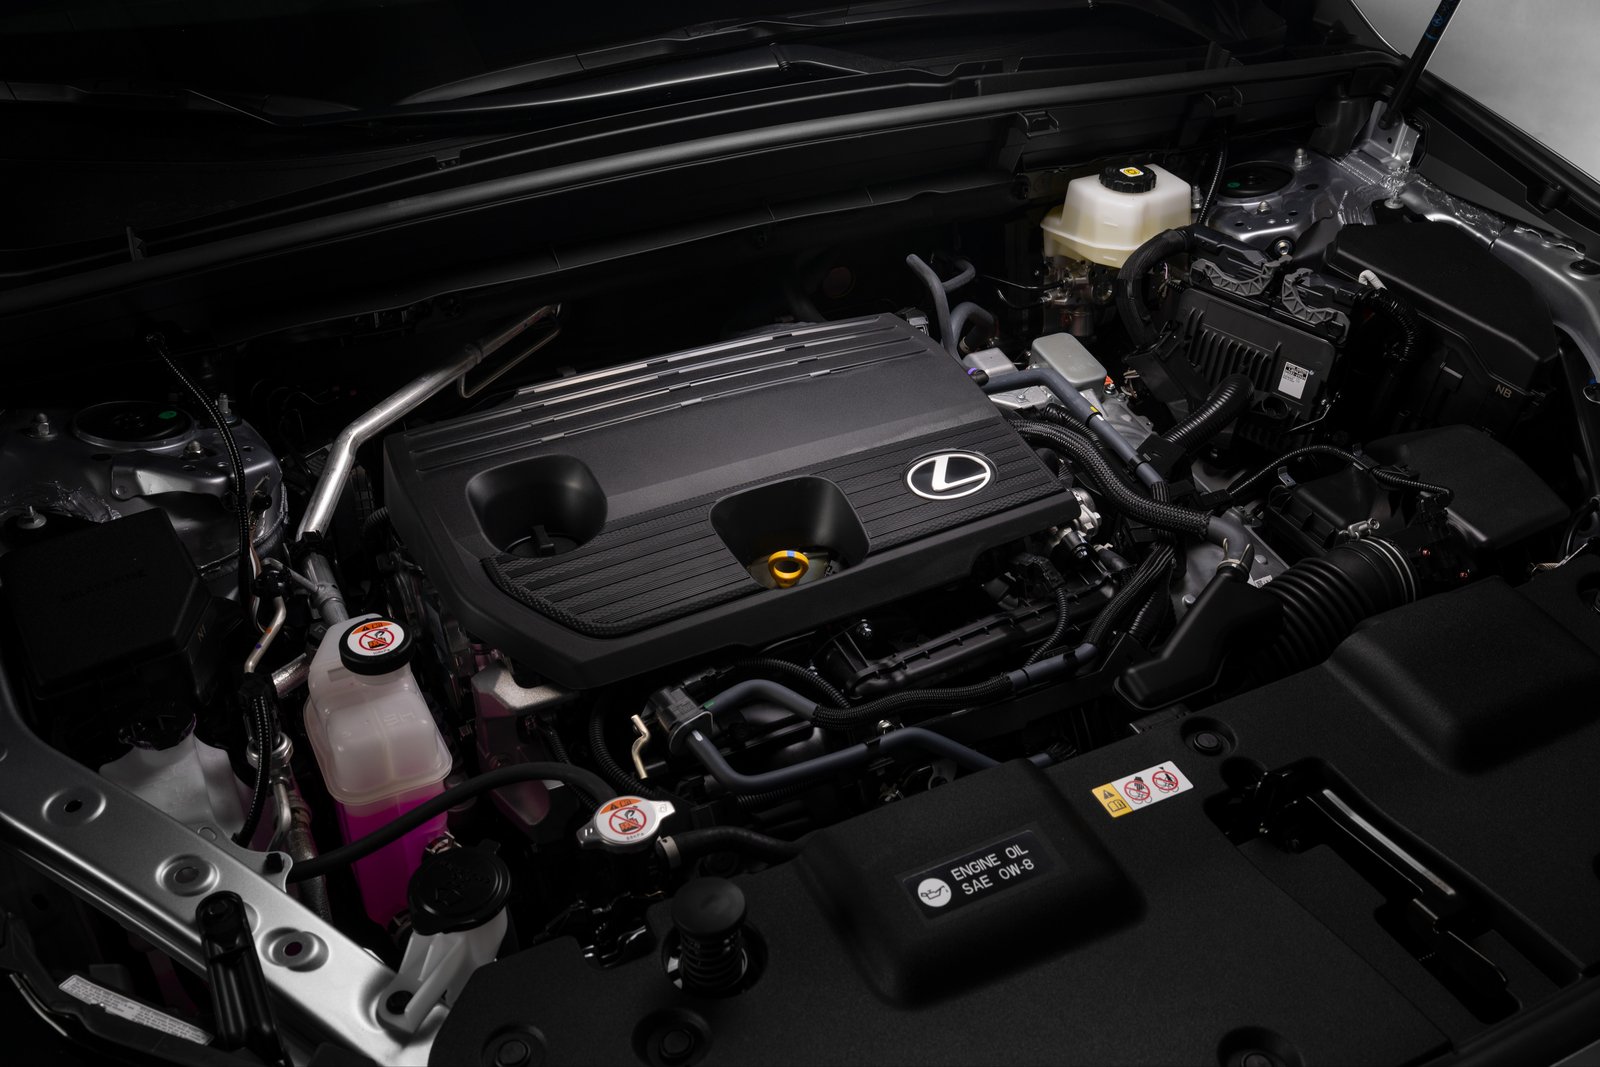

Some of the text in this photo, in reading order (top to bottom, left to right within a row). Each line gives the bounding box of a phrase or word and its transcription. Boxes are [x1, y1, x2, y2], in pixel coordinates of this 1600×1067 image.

[1495, 384, 1512, 398] NB
[950, 844, 1029, 881] ENGINE OIL
[961, 858, 1035, 895] SAE 0W-8
